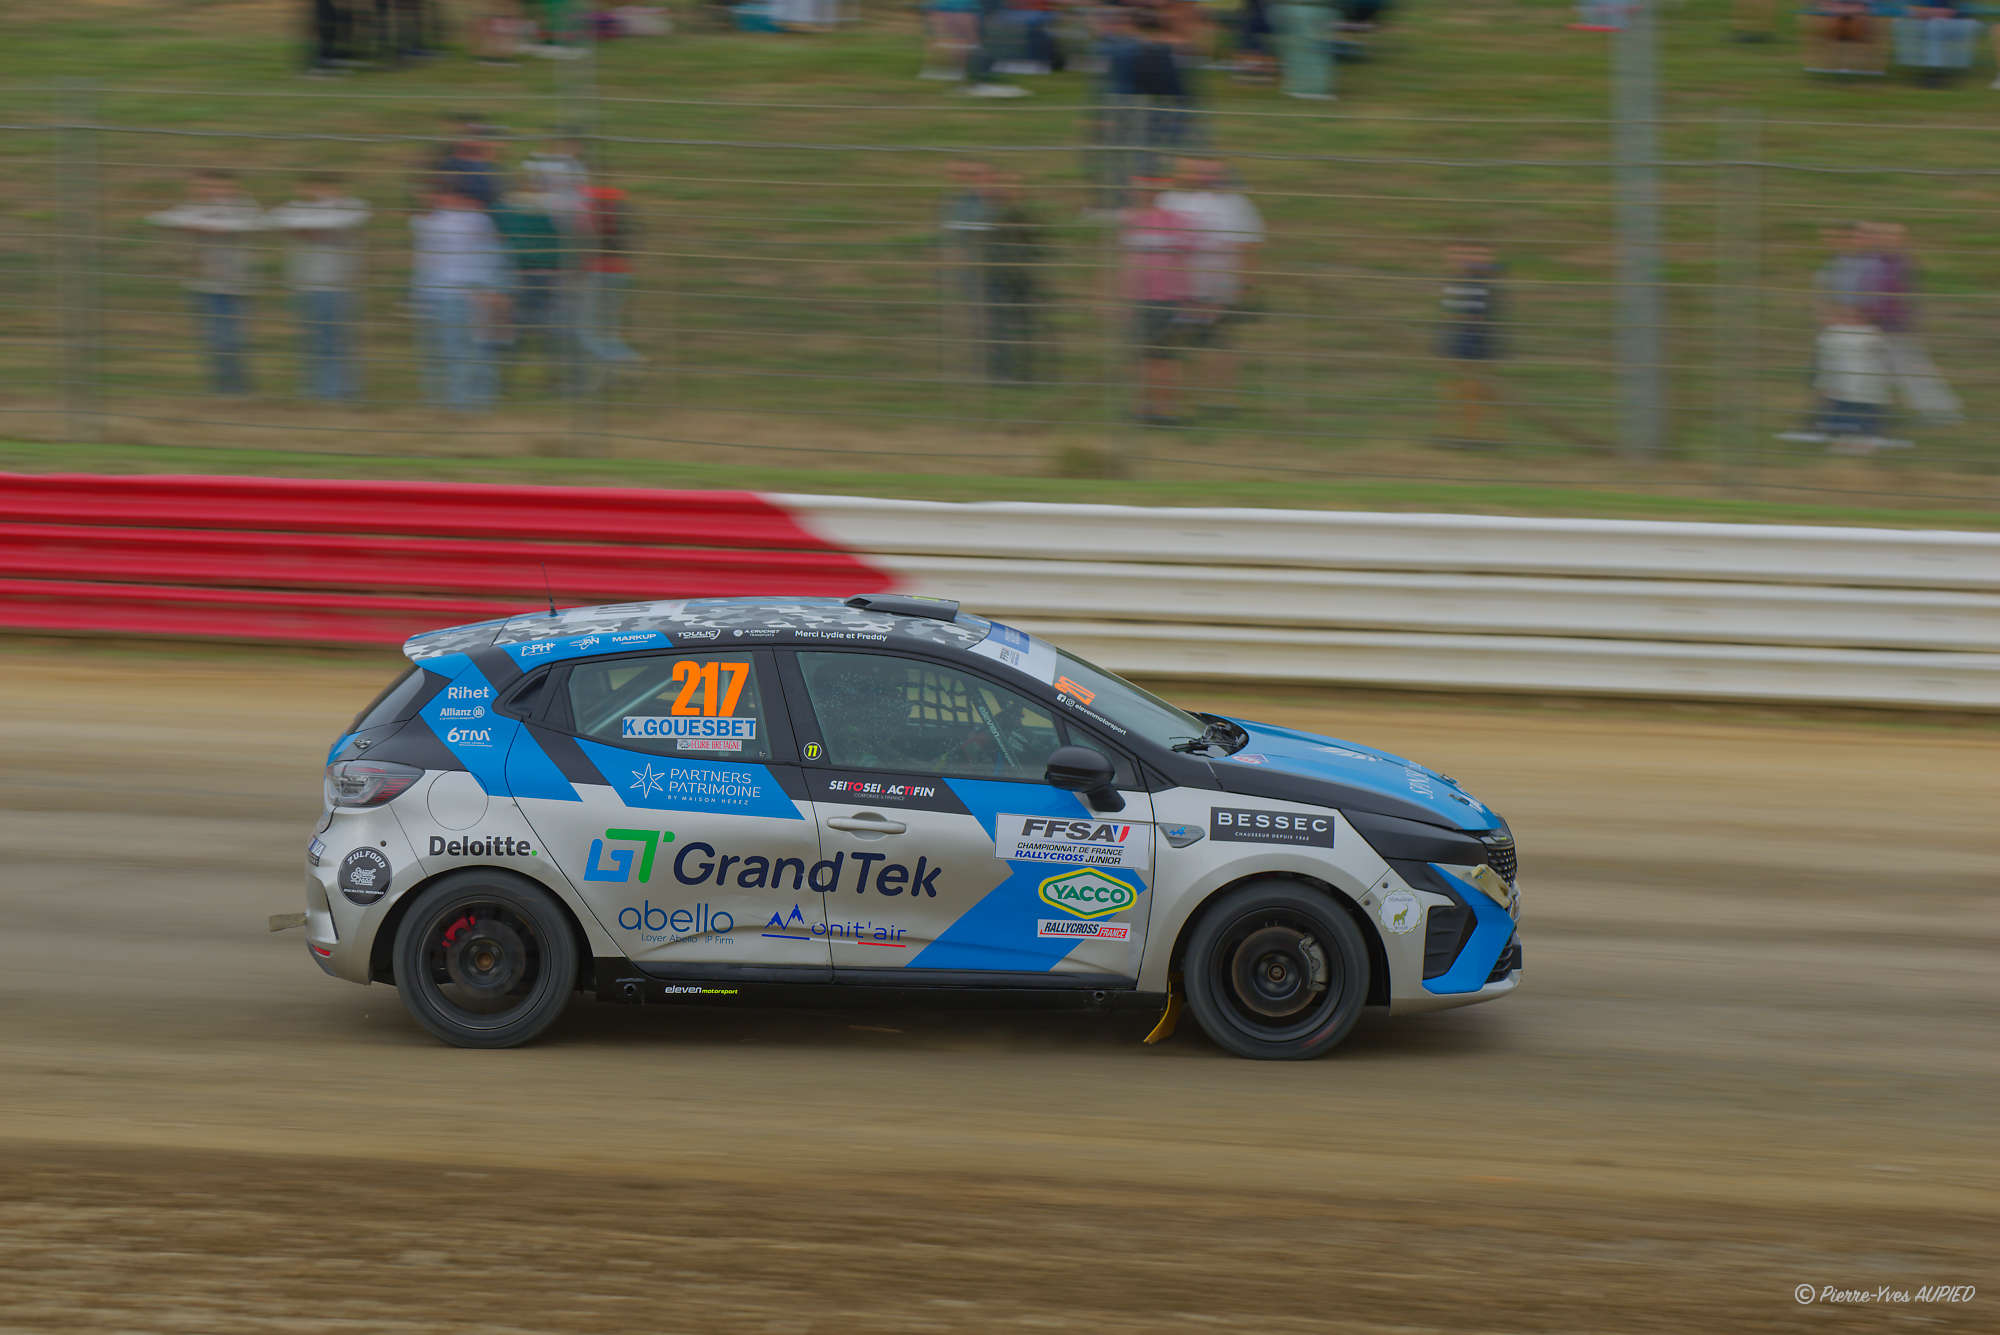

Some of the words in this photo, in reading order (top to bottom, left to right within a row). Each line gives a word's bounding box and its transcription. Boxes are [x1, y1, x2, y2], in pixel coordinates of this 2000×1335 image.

[612, 633, 657, 643] MARKUP
[795, 630, 819, 638] Merci
[821, 631, 845, 640] Lydie
[857, 632, 887, 642] Freddy
[447, 686, 490, 700] Rihet
[671, 660, 750, 717] 217
[440, 707, 472, 717] Allianz
[623, 718, 756, 738] K.GOUESBET
[807, 744, 818, 757] 11
[670, 768, 752, 784] PARTNERS
[669, 781, 761, 798] PATRIMOINE
[887, 785, 935, 798] ACTIFIN
[682, 795, 716, 803] MAISON
[1217, 812, 1328, 832] BESSEC
[1021, 818, 1115, 843] FFSA
[1017, 842, 1078, 853] CHAMPIONNAT
[1079, 846, 1089, 854] DE
[1090, 847, 1123, 856] FRANCE
[347, 850, 386, 868] ZULFOOD
[1015, 850, 1084, 862] RALLYCROSS
[1085, 854, 1121, 865] JUNIOR
[674, 842, 942, 897] GrandTek
[1053, 884, 1126, 904] YACCO
[618, 899, 734, 934] abello
[1044, 922, 1099, 935] RALLYCROSS
[1100, 927, 1127, 938] FRANCE
